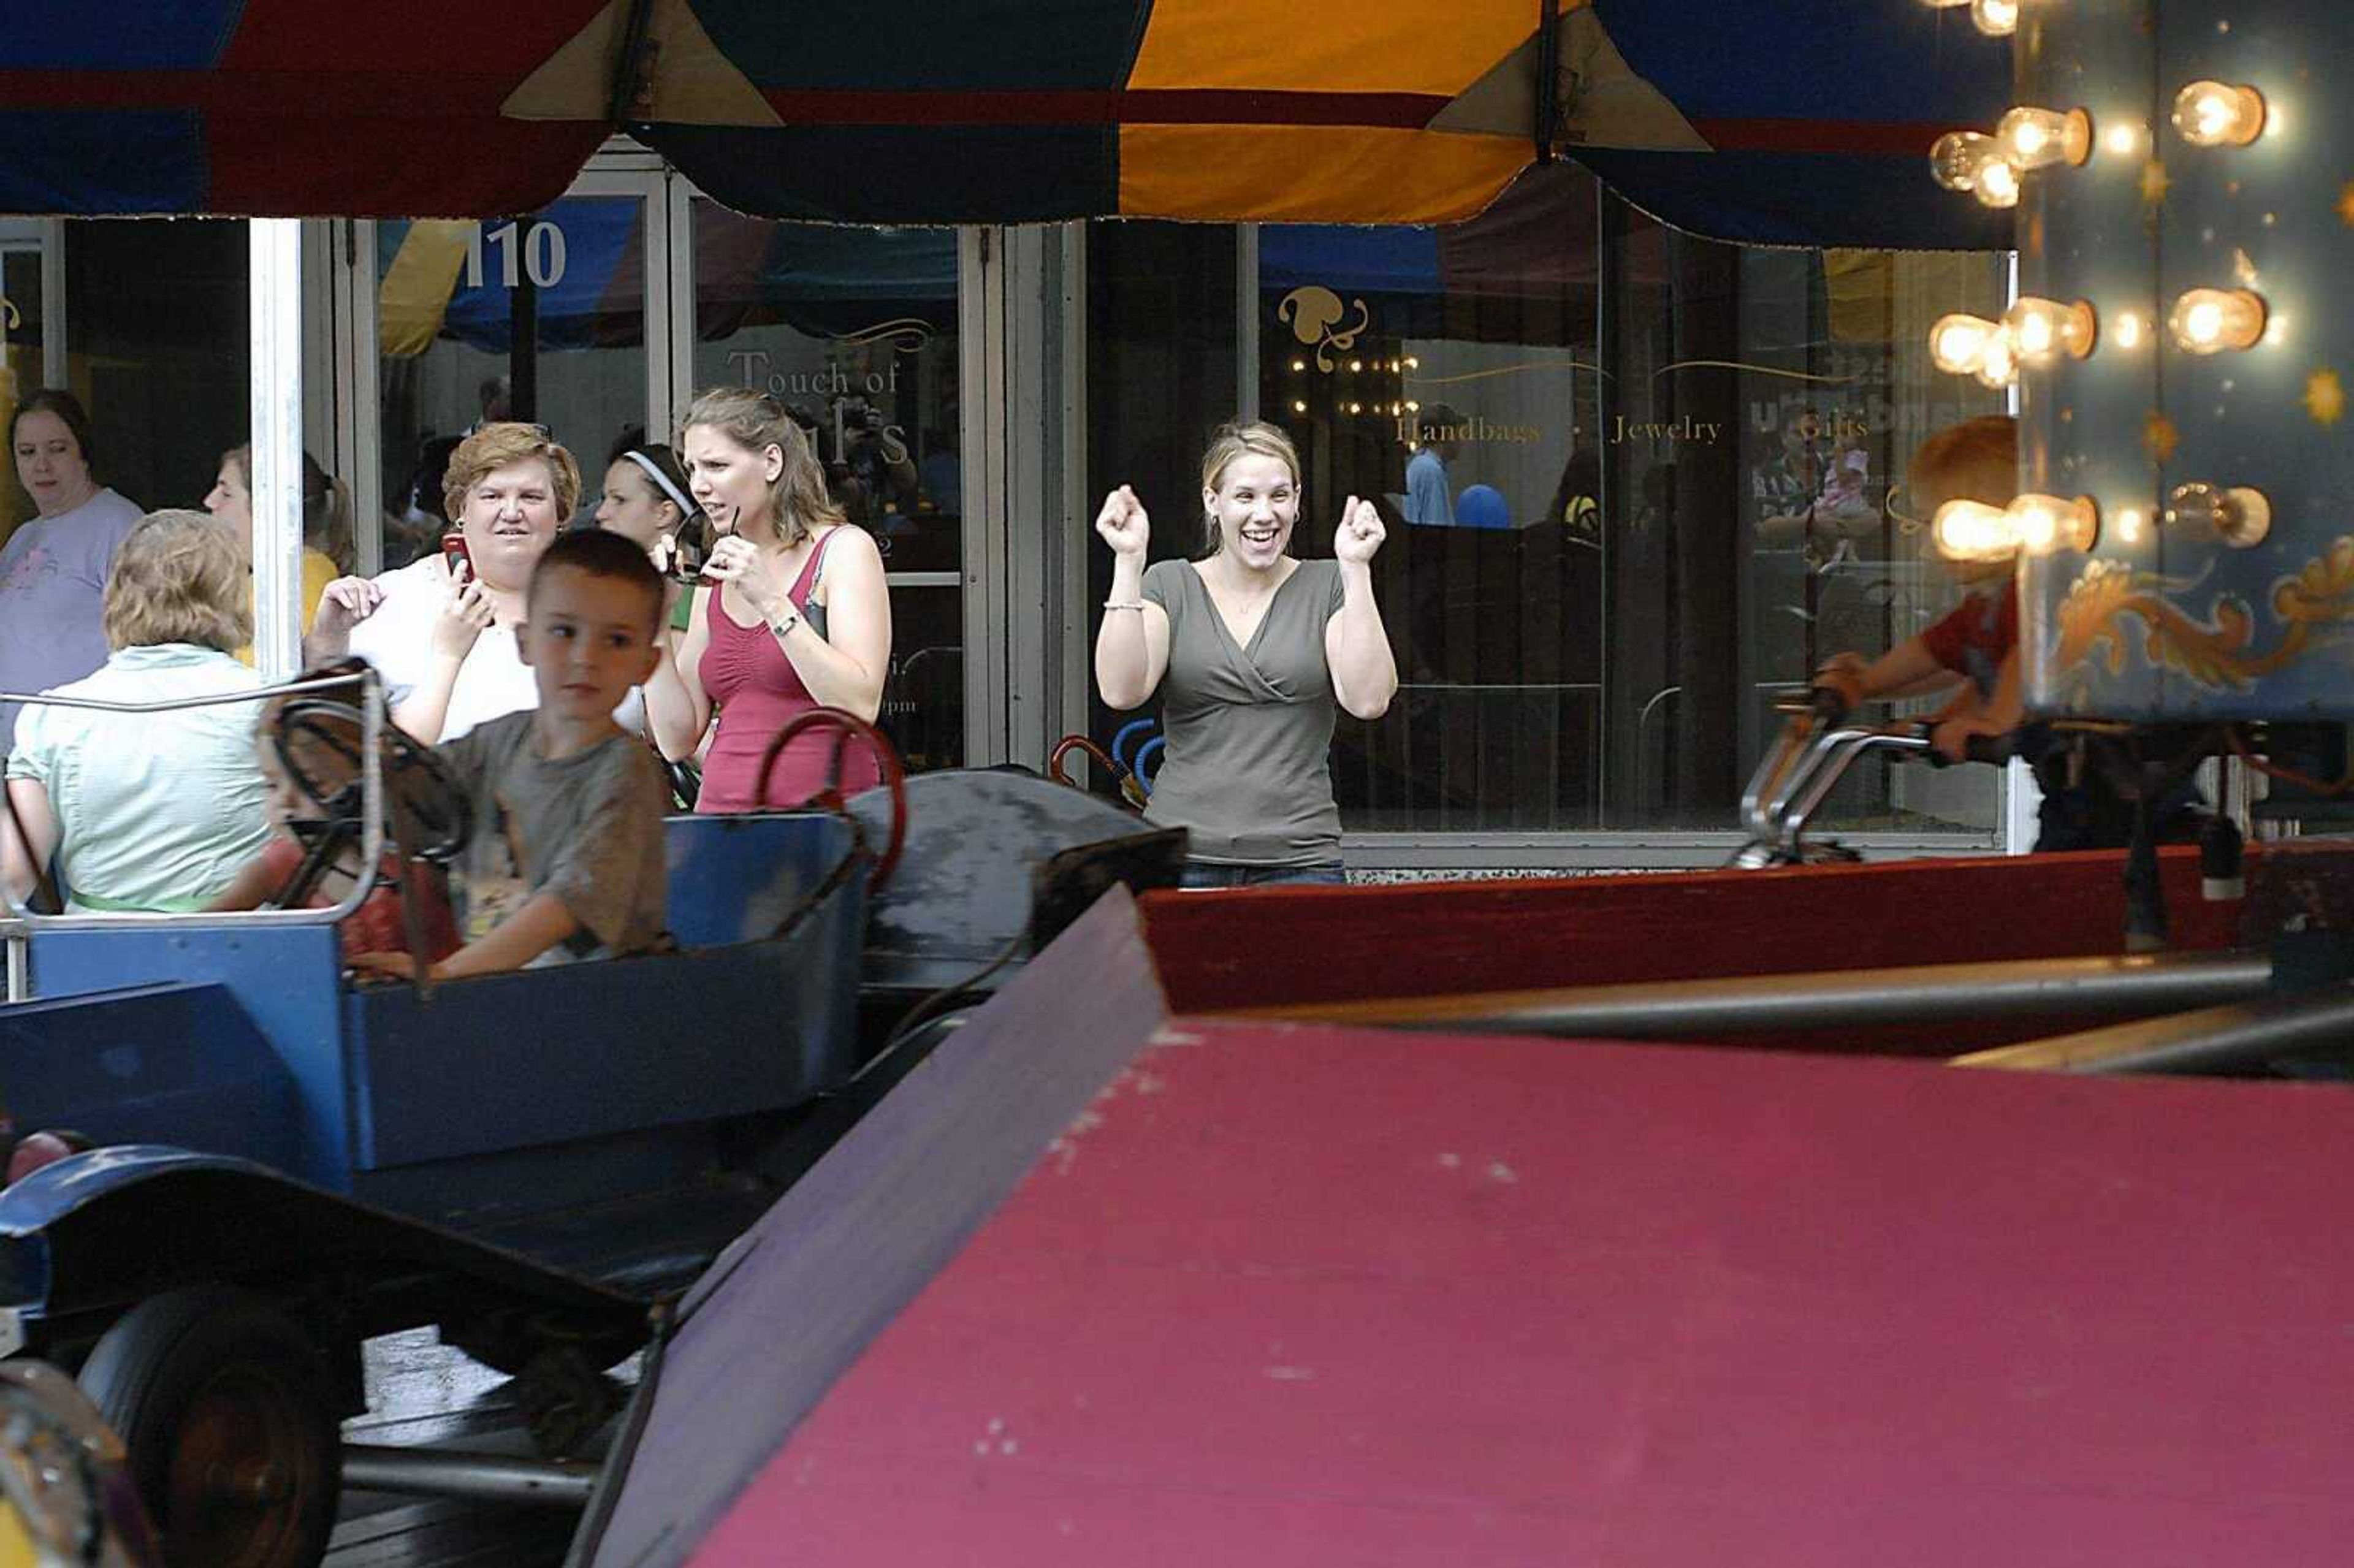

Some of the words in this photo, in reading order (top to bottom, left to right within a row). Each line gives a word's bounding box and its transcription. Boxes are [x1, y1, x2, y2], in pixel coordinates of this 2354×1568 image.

[449, 221, 566, 287] 110
[727, 351, 849, 394] Touch
[866, 362, 901, 394] of
[1395, 416, 1541, 443] Handbags
[1610, 414, 1721, 445] Jewelry
